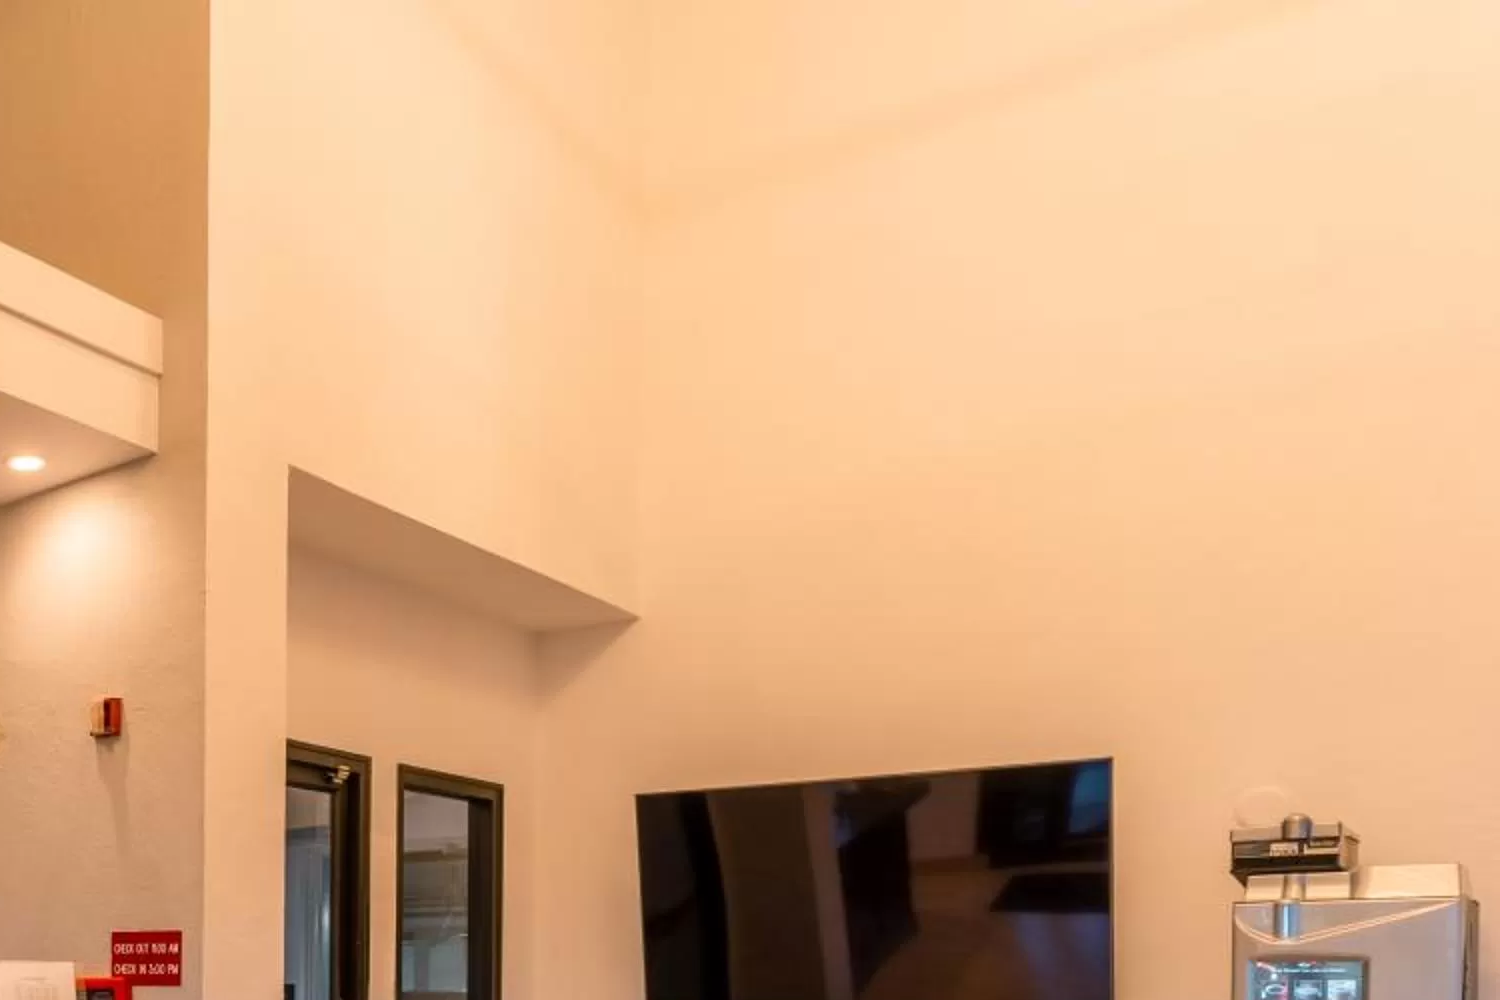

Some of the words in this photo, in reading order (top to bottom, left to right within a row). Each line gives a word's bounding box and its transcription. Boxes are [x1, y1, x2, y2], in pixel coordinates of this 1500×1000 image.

[113, 943, 134, 955] CHECK
[135, 943, 149, 955] OUT
[168, 943, 179, 955] AM
[113, 963, 137, 975] CHECK
[138, 963, 147, 975] IN
[167, 963, 179, 975] PM
